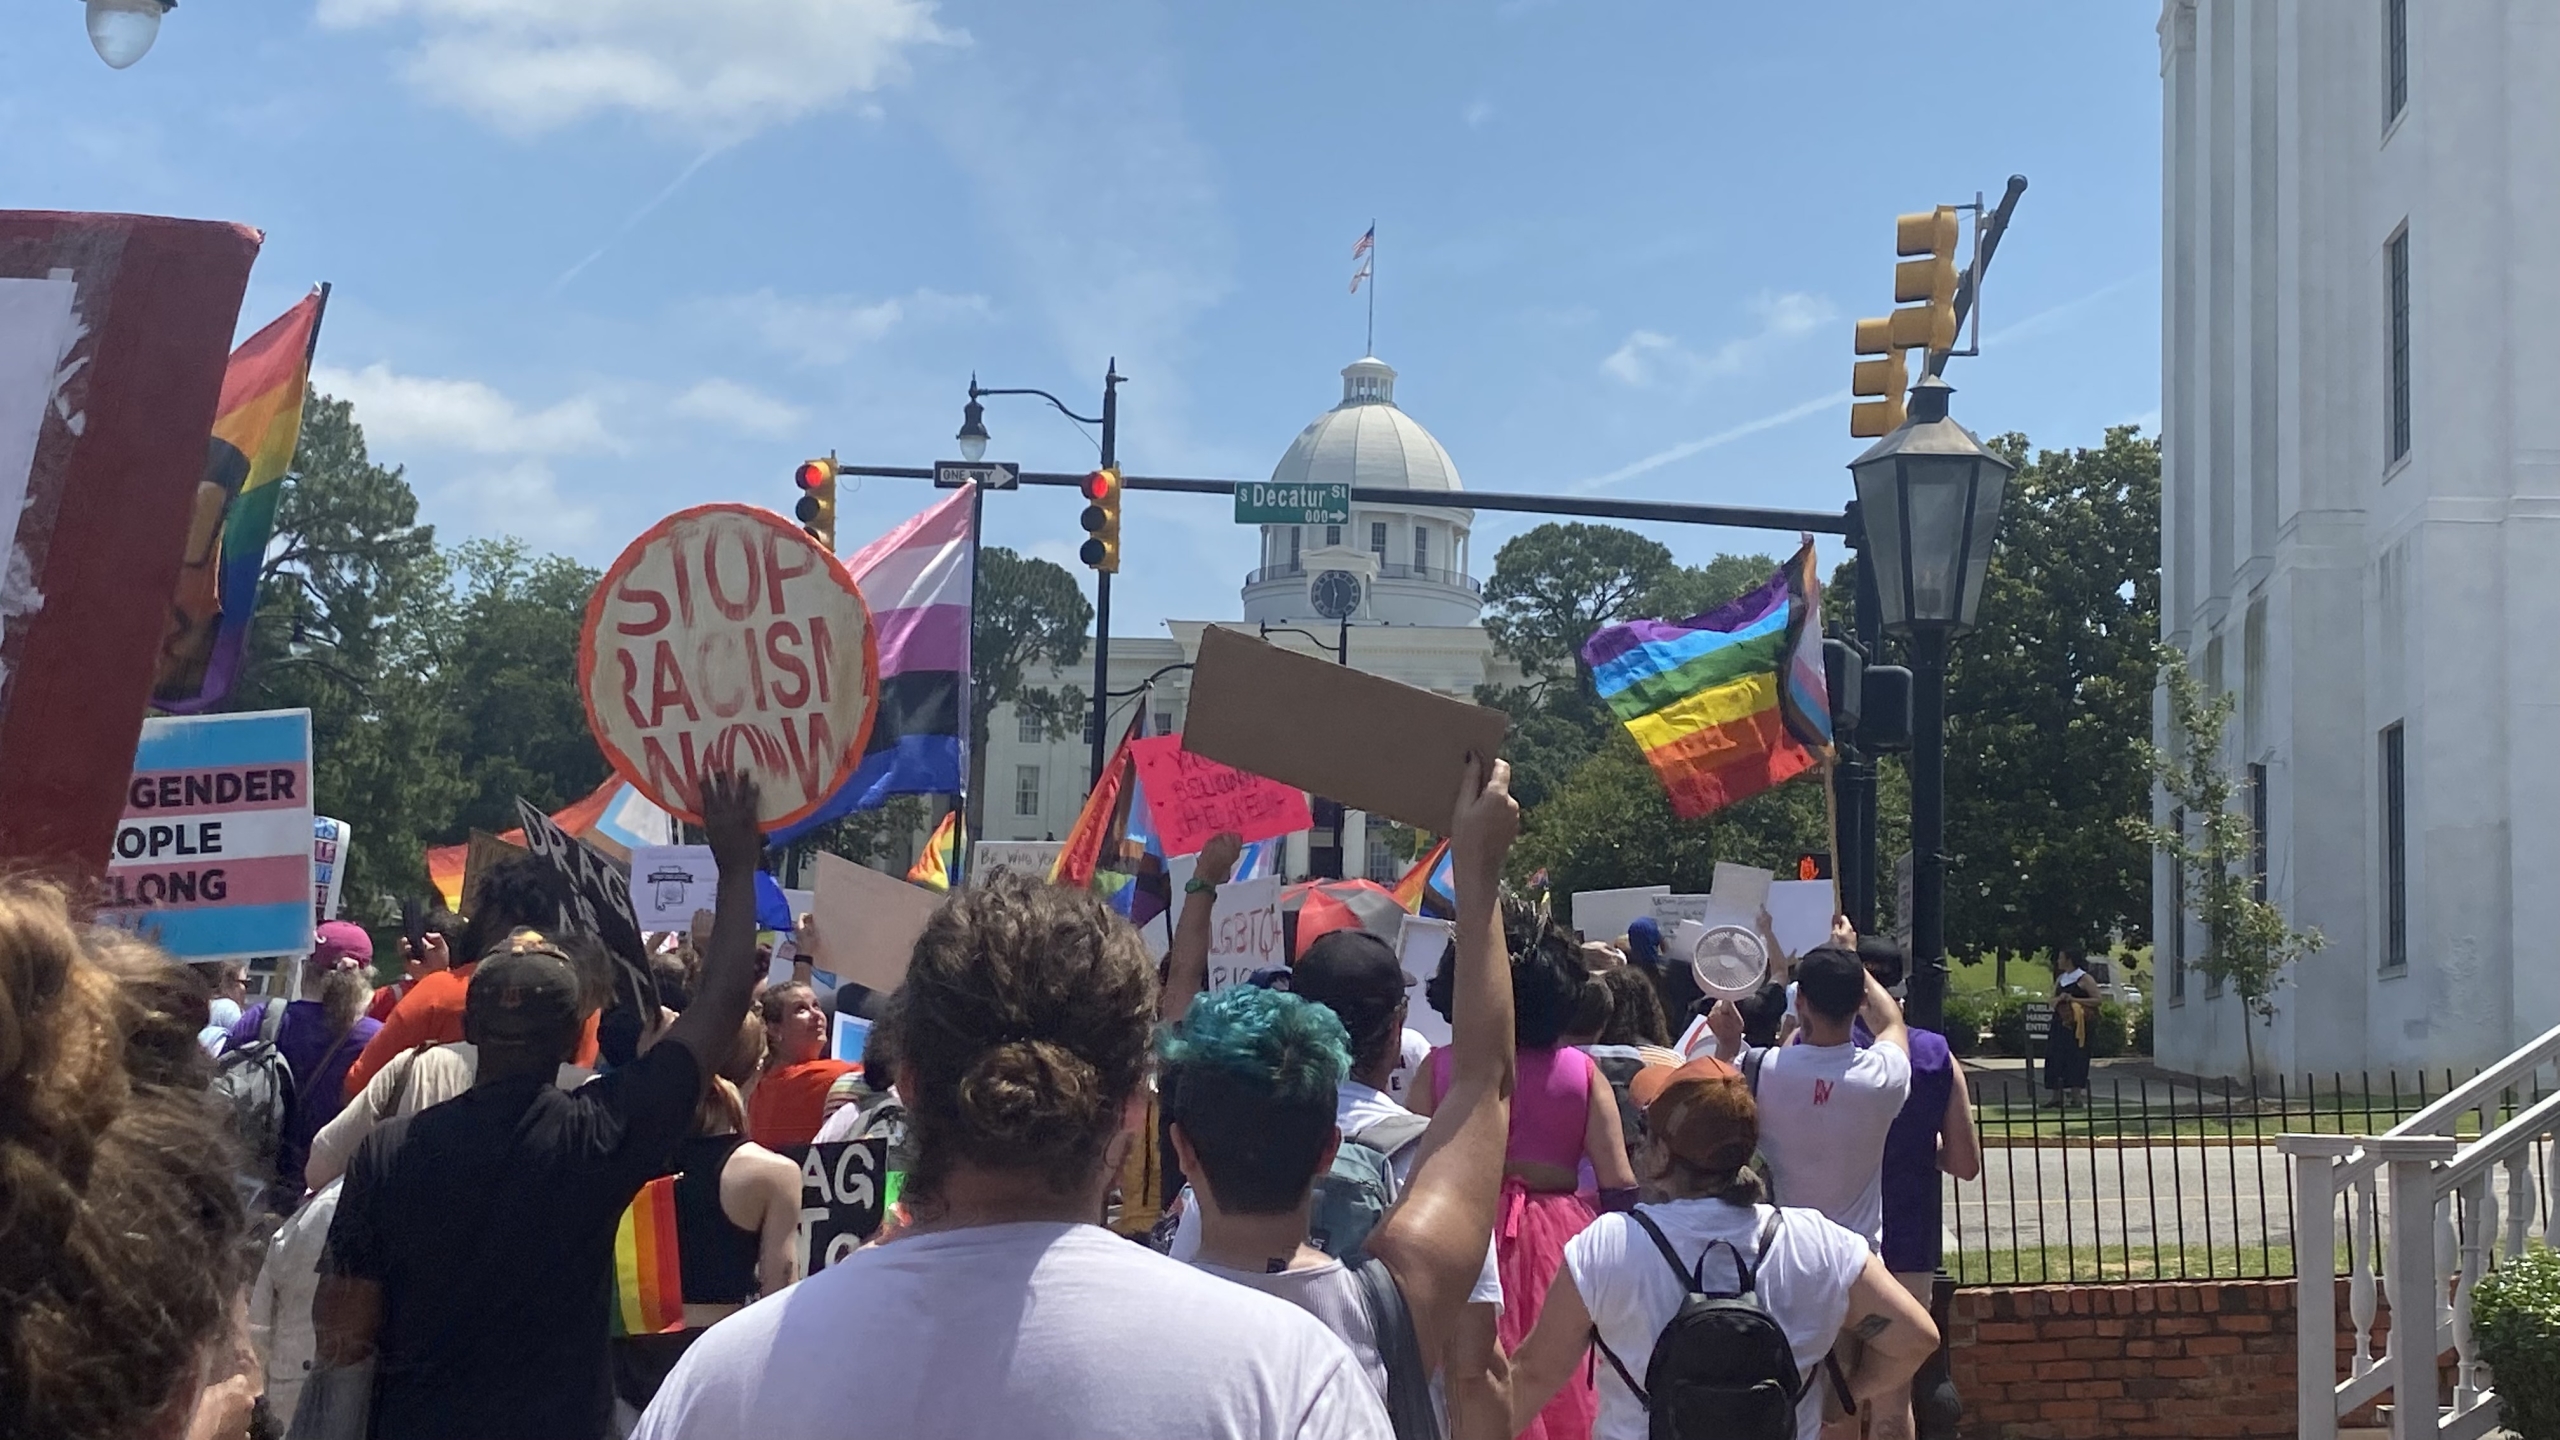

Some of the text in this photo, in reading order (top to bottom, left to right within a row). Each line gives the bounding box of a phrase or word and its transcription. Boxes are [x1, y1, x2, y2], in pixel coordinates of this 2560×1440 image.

[942, 469, 994, 481] ONE WY
[1240, 483, 1347, 508] S Decatur St
[616, 523, 817, 638] STOP
[110, 821, 223, 860] OPLE
[517, 798, 637, 931] DRAG
